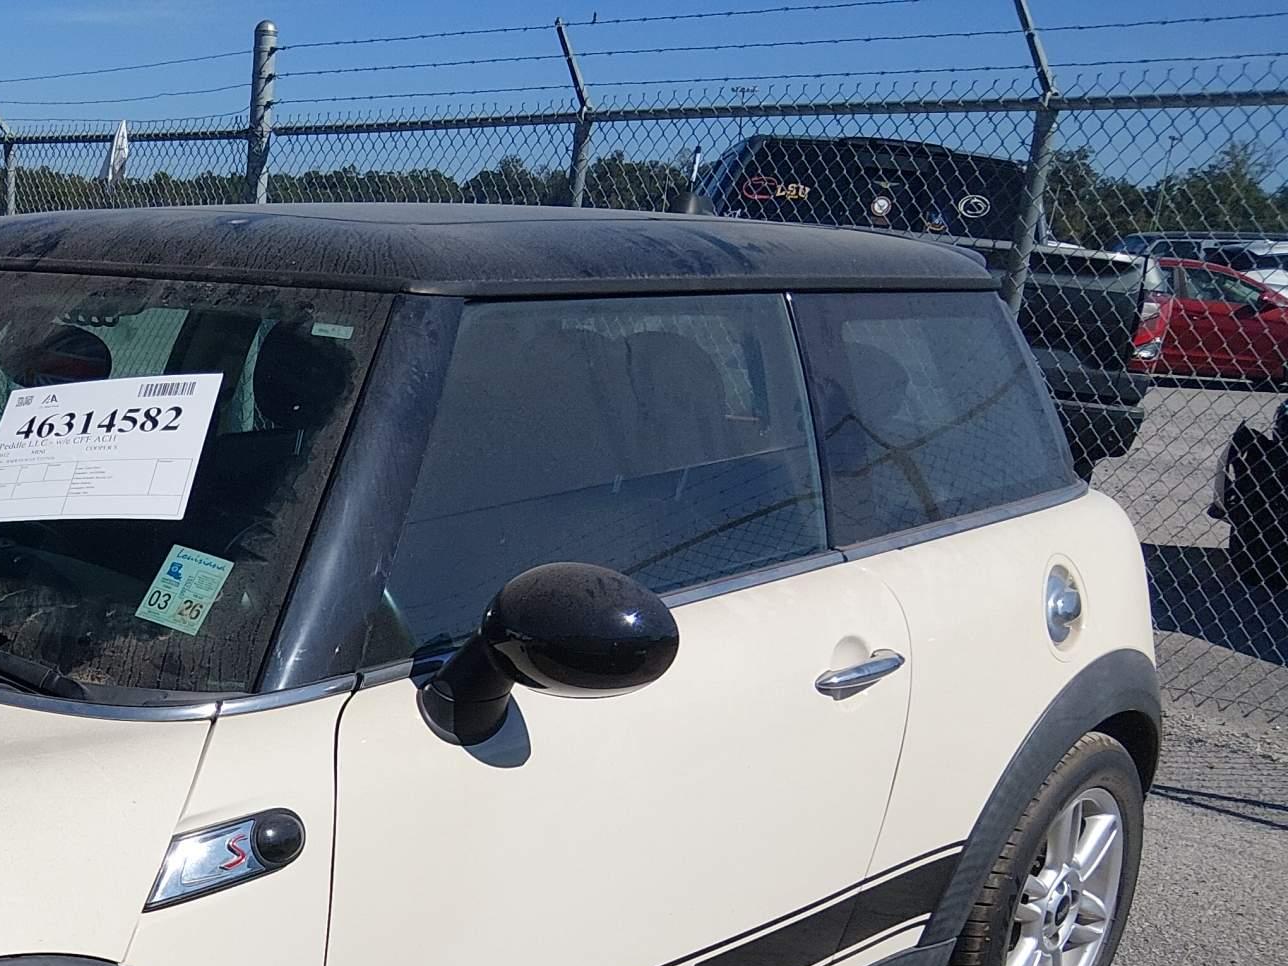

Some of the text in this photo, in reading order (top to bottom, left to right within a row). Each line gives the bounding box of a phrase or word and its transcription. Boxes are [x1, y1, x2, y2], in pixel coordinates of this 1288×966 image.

[775, 183, 811, 199] LSU
[15, 406, 183, 439] 46314582
[0, 440, 27, 450] Peddle
[176, 549, 226, 572] Louisiana
[148, 590, 204, 620] 03 26
